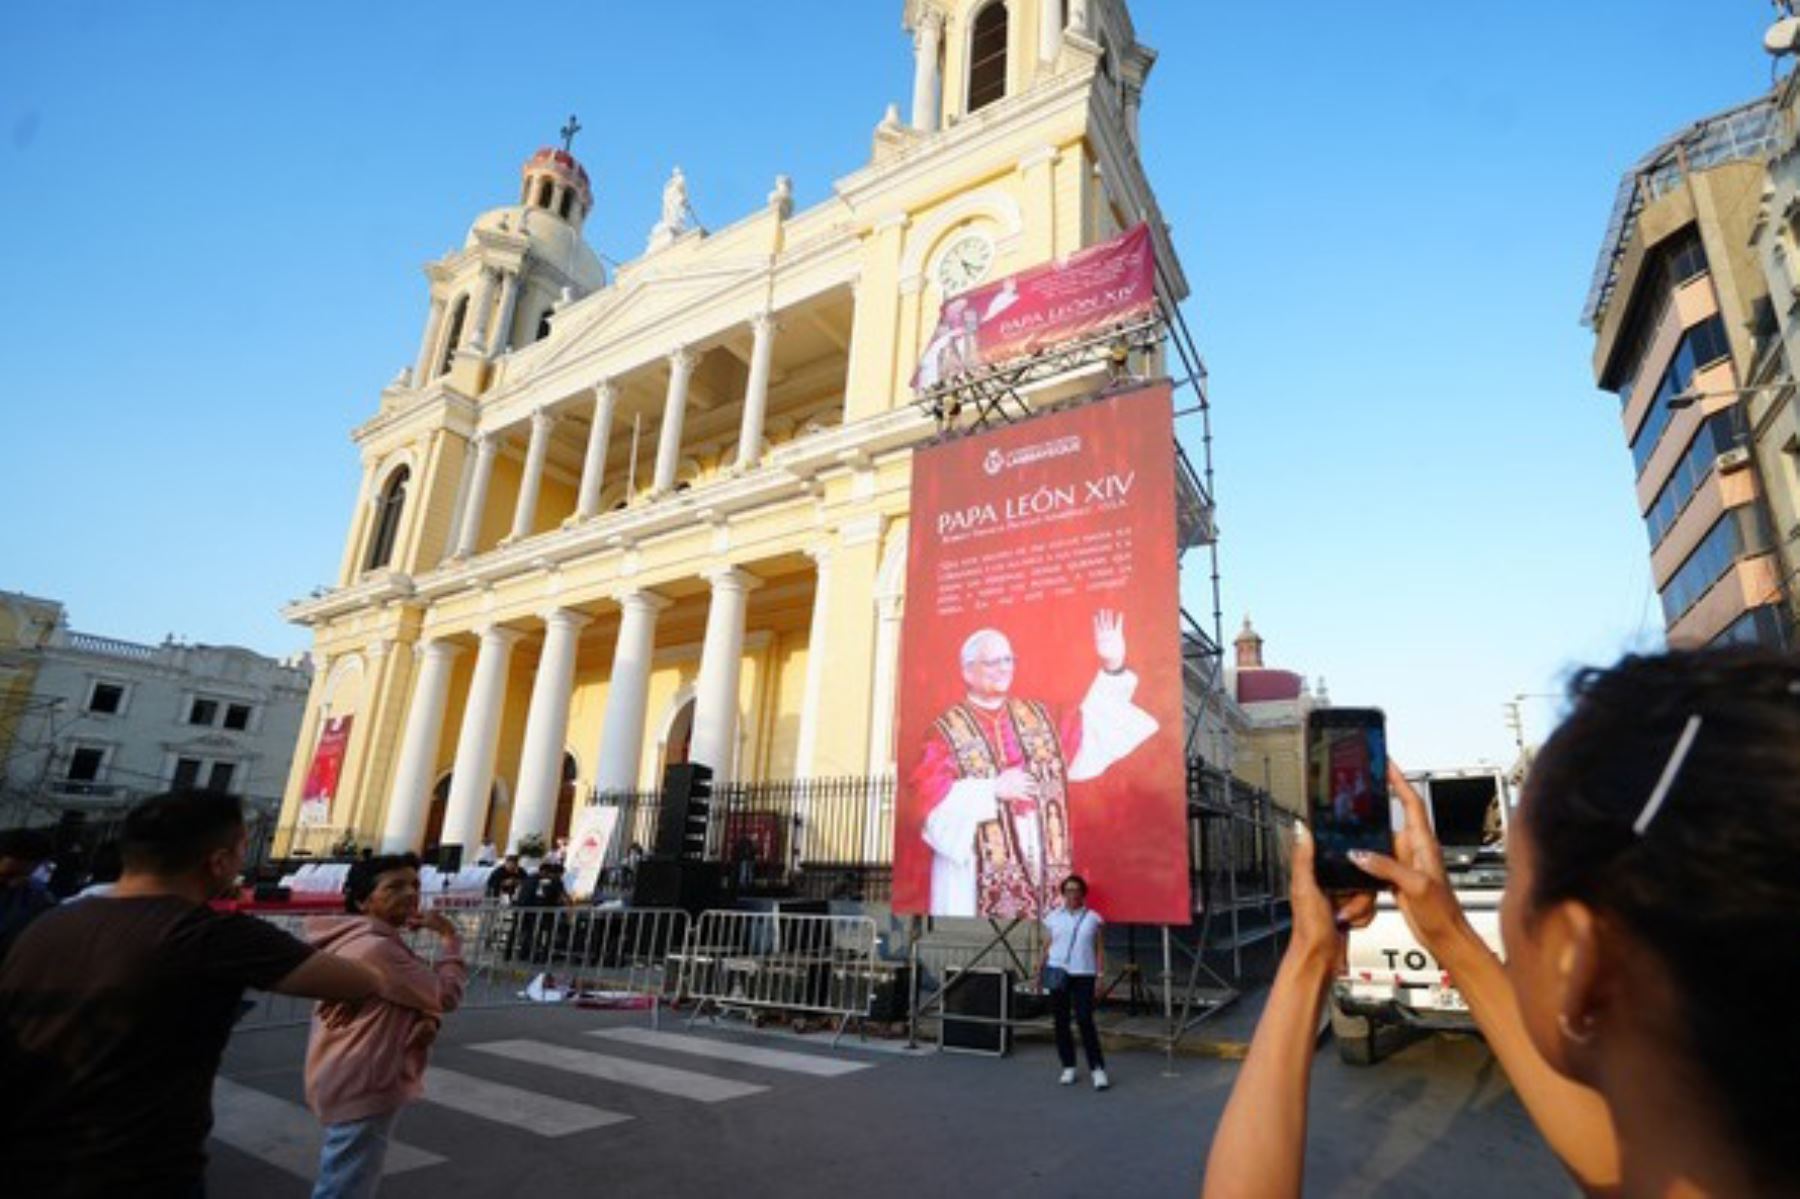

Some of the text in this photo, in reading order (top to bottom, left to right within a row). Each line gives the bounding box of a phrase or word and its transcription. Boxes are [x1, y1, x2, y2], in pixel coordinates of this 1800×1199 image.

[938, 504, 997, 534] PAPA
[1005, 485, 1075, 520] LEÓN
[1085, 471, 1134, 503] XIV
[1381, 949, 1427, 970] TO
